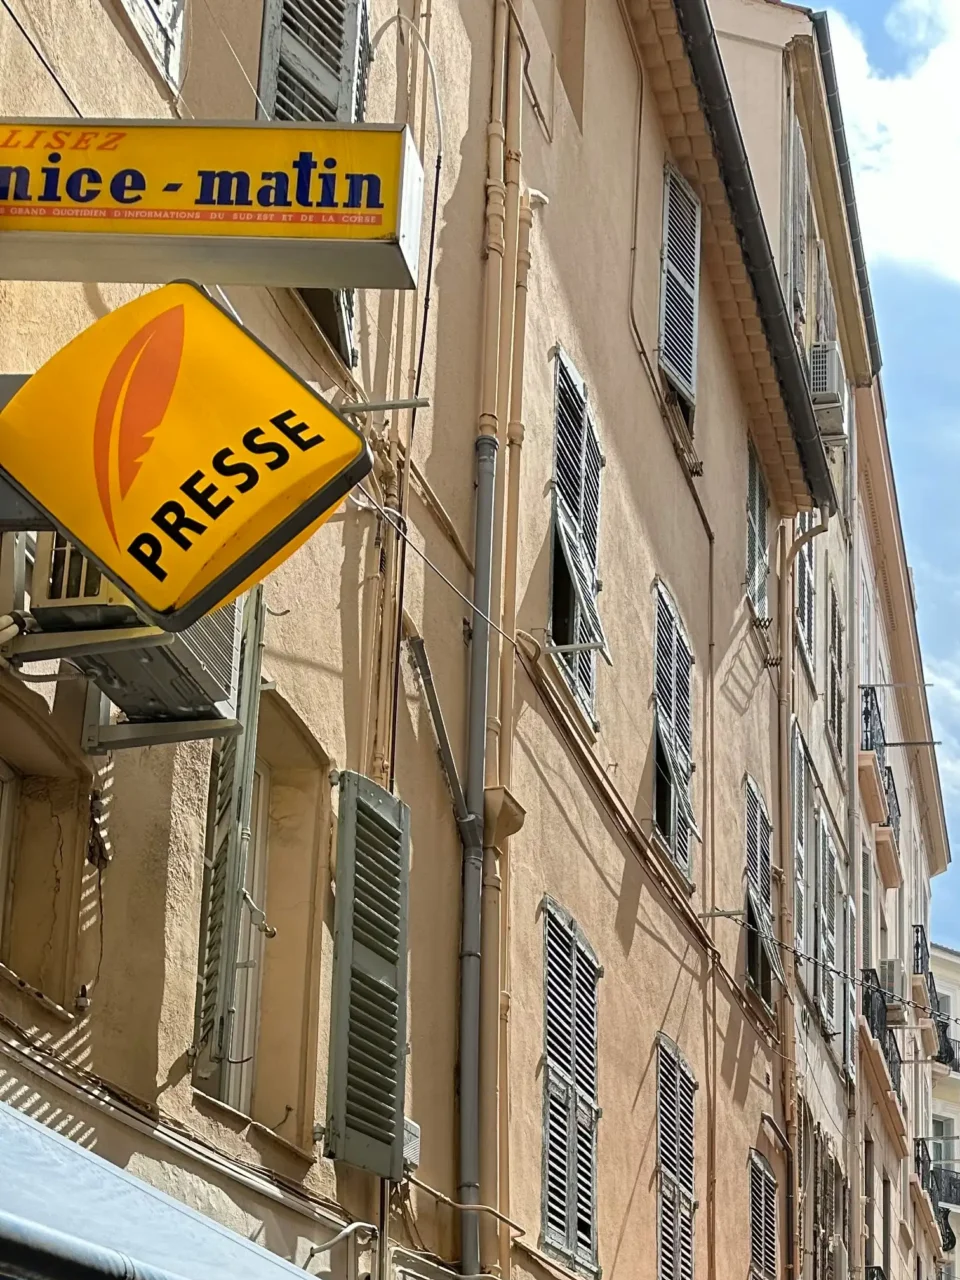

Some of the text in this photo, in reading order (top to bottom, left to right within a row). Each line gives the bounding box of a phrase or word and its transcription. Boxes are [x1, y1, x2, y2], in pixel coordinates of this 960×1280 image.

[1, 129, 127, 151] LISEZ
[195, 151, 384, 208] matin
[10, 207, 47, 216] GRAND
[52, 208, 107, 217] QUOTIDIEN
[210, 211, 225, 220] DU
[281, 213, 294, 222] ET
[321, 215, 335, 223] LA
[341, 215, 377, 223] CORSE
[127, 409, 325, 583] PRESSE
